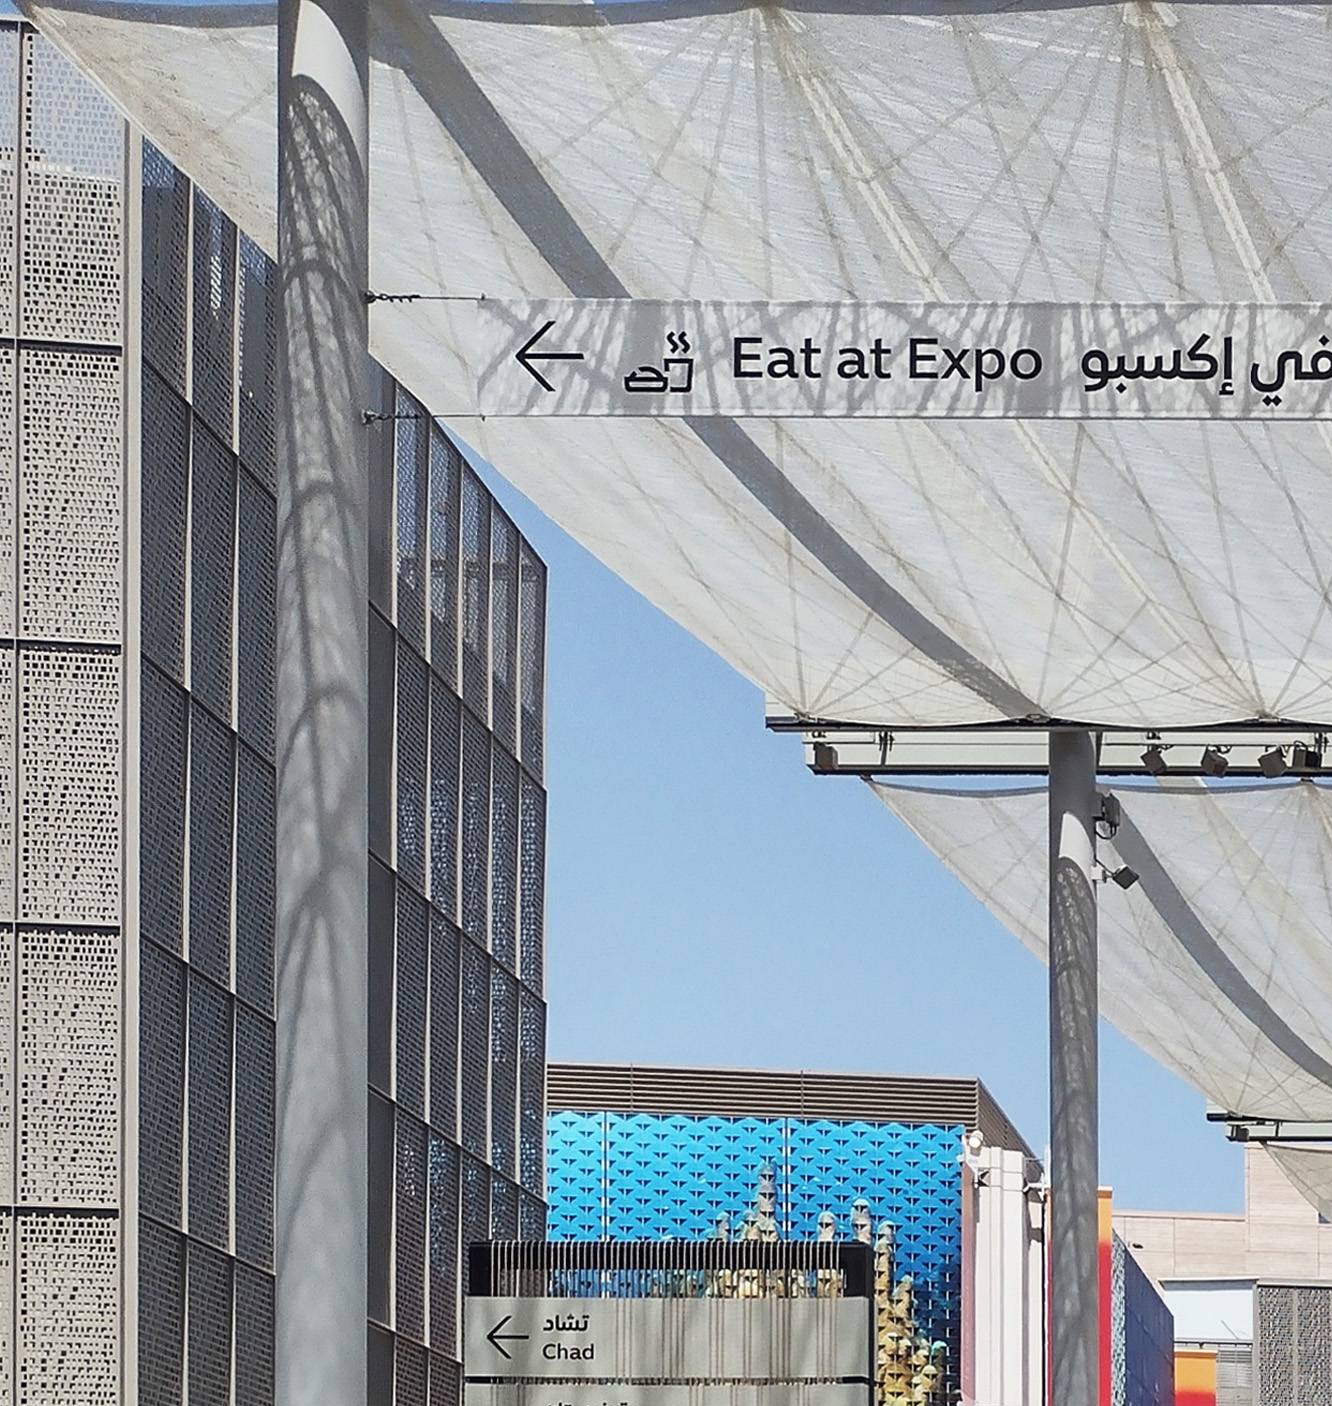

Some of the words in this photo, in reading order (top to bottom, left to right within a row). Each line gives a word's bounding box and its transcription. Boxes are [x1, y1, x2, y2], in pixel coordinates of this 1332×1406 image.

[734, 336, 820, 379] Eat
[836, 341, 889, 379] at
[908, 336, 1043, 391] Expo
[1081, 336, 1233, 396] إكسبو
[543, 1315, 588, 1331] تشاد
[543, 1343, 594, 1360] Chad
